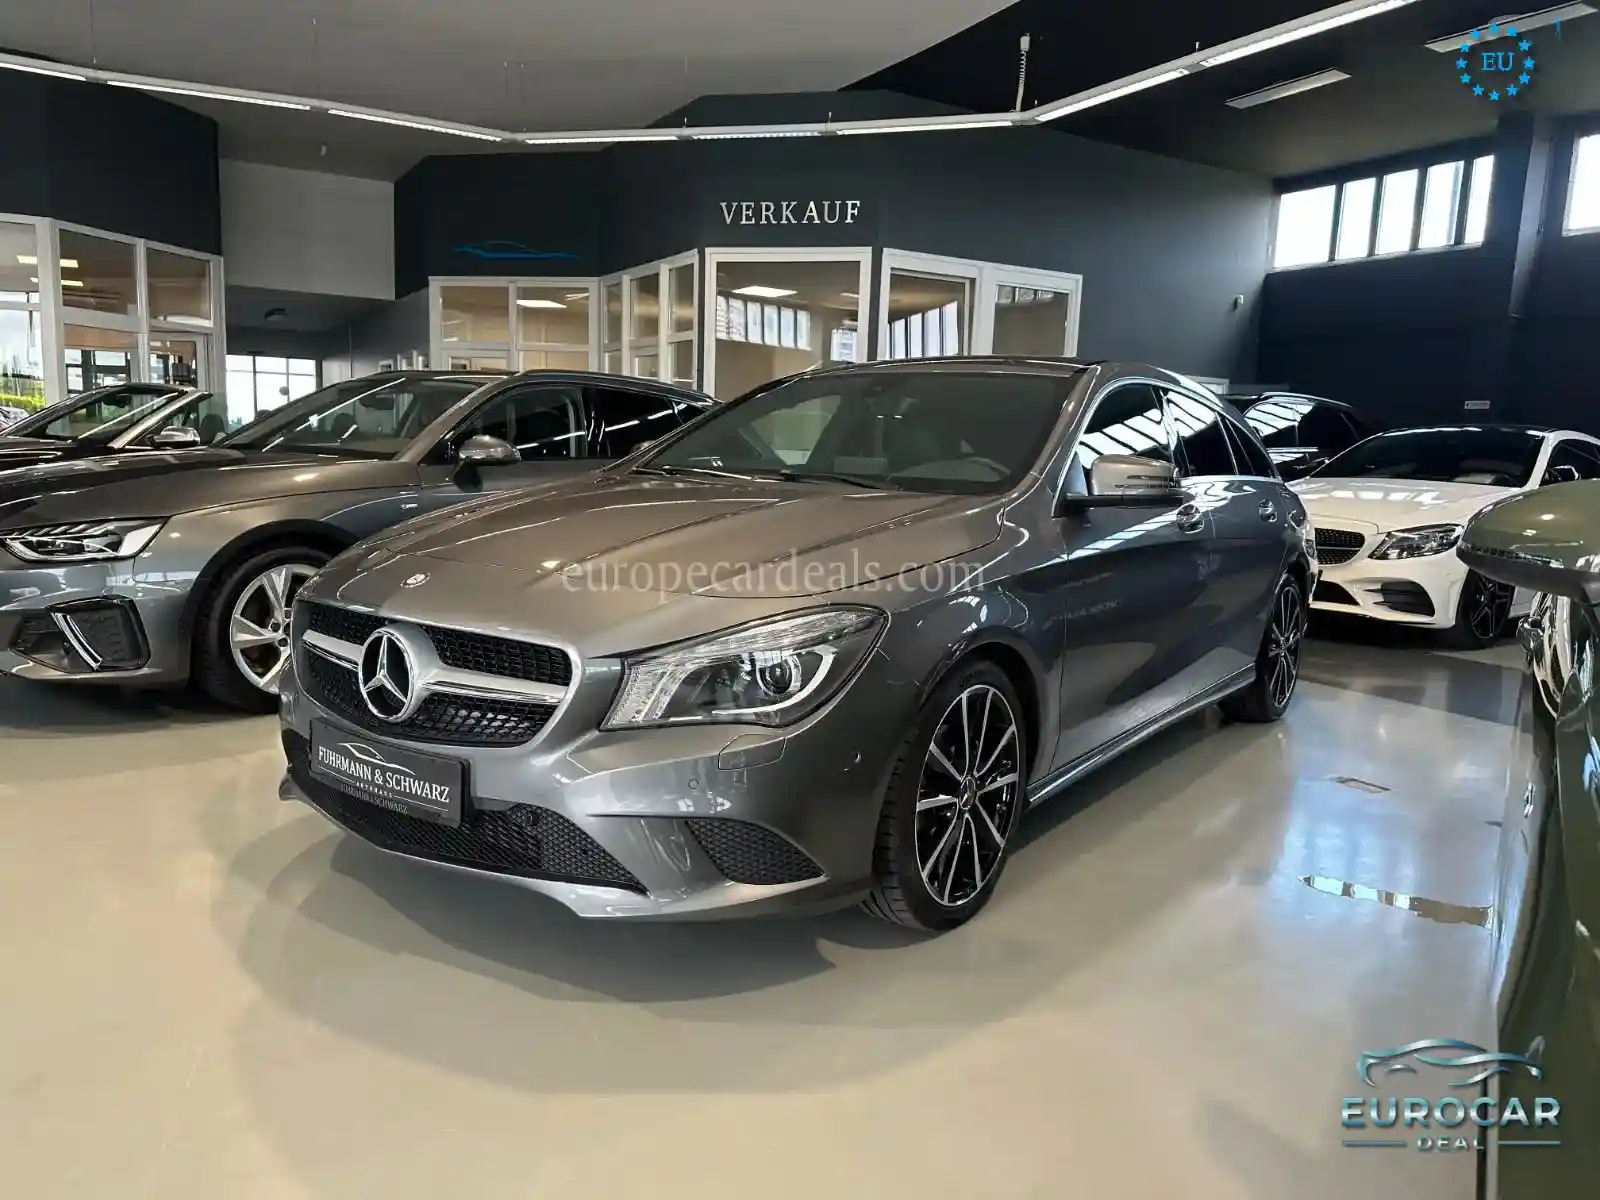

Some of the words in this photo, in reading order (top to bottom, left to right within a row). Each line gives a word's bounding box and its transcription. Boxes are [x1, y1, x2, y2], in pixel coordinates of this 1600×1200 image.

[720, 201, 861, 225] VERKAUF
[318, 745, 372, 782] FUHRMANN
[374, 768, 384, 785] &
[385, 772, 450, 804] SCHWARZ
